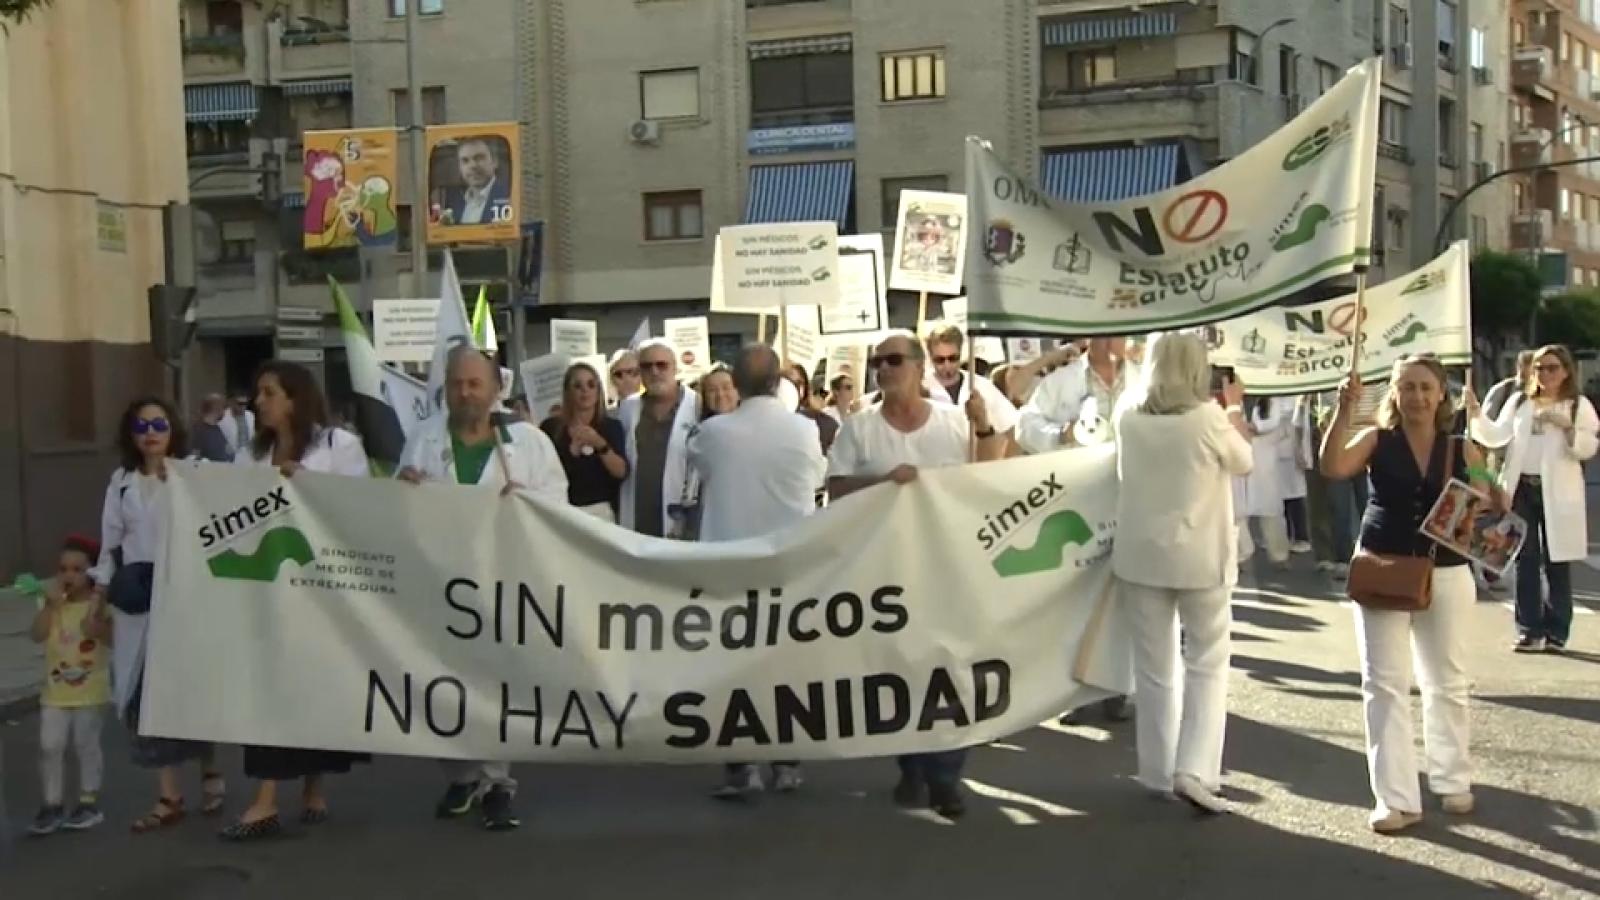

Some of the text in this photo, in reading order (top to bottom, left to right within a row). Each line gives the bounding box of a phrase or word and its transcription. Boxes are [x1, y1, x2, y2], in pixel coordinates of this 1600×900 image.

[489, 204, 513, 222] 10
[1119, 241, 1250, 286] Estatuto
[198, 485, 291, 548] simex
[976, 472, 1064, 550] simex
[320, 547, 395, 564] SINDICATO
[289, 577, 397, 594] EXTREMADURA
[444, 577, 909, 651] SIN médicos
[364, 657, 1012, 749] NO HAY SANIDAD
